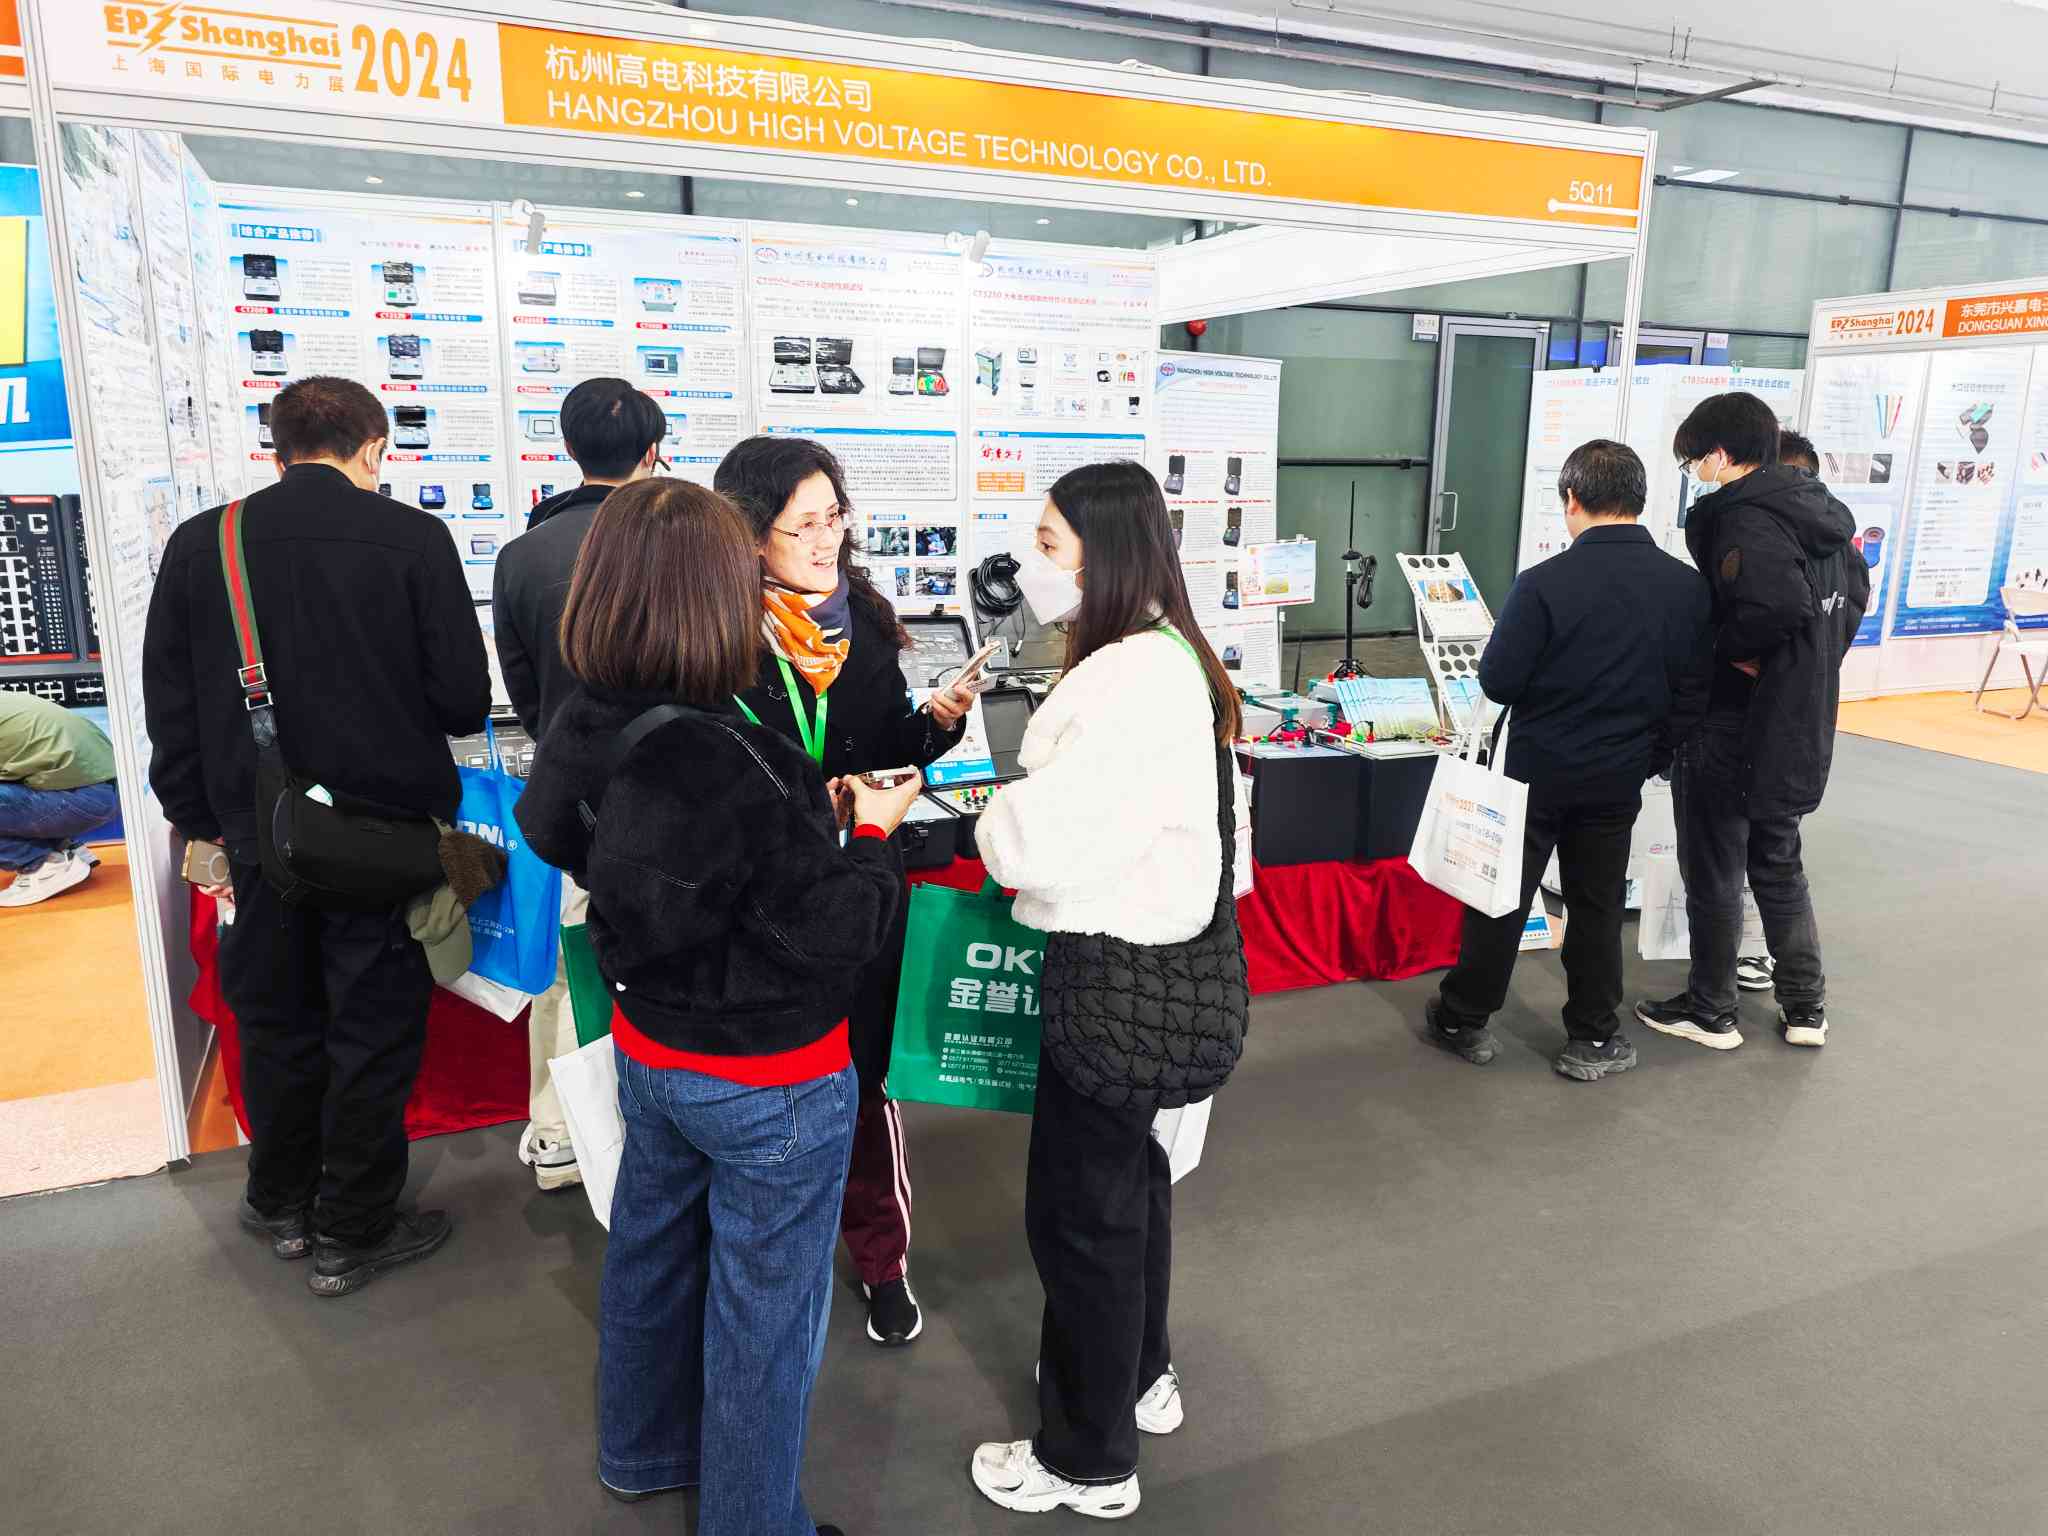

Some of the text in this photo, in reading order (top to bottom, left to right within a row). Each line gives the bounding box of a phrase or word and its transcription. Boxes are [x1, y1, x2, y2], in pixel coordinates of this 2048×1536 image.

[104, 5, 472, 103] EP Shanghai 2024
[111, 54, 345, 93] 上海国际电力展
[544, 44, 873, 113] 杭州高电科技有限公司
[547, 89, 1272, 188] HANGZHOU HIGH VOLTAGE TECHNOLOGY CO., LTD.
[1568, 180, 1614, 206] 5Q11
[1850, 316, 1894, 328] Shanghai
[1896, 309, 1935, 336] 2024
[1958, 318, 2023, 334] DONGGUAN
[966, 943, 1044, 975] OK
